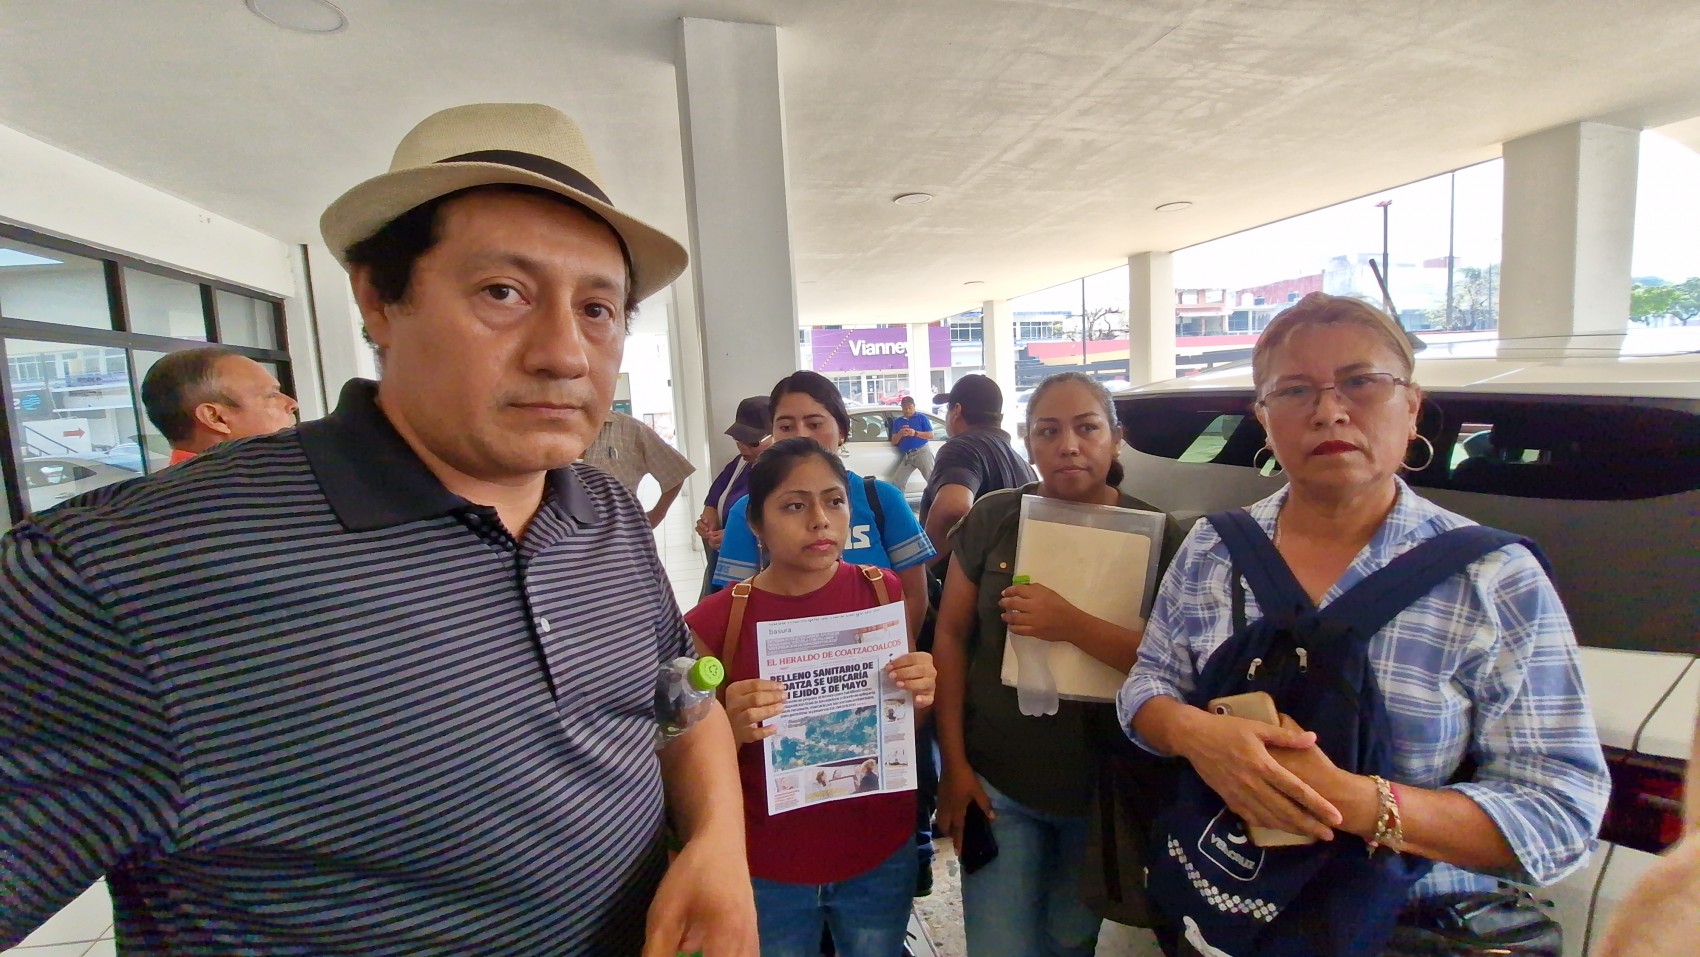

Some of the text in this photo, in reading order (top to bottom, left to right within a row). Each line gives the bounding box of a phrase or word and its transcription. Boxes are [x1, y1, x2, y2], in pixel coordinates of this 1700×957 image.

[767, 658, 777, 667] EL
[779, 653, 820, 665] HERALDO
[822, 651, 833, 659] DE
[834, 639, 902, 657] COATZACOALCOS
[813, 666, 860, 678] SANITARIO
[862, 661, 874, 670] DE
[783, 670, 868, 691] OATZA SE UBICARÍA
[792, 687, 819, 698] EJIDO
[821, 686, 827, 695] 5
[828, 684, 840, 693] DE
[841, 680, 868, 691] MAYO
